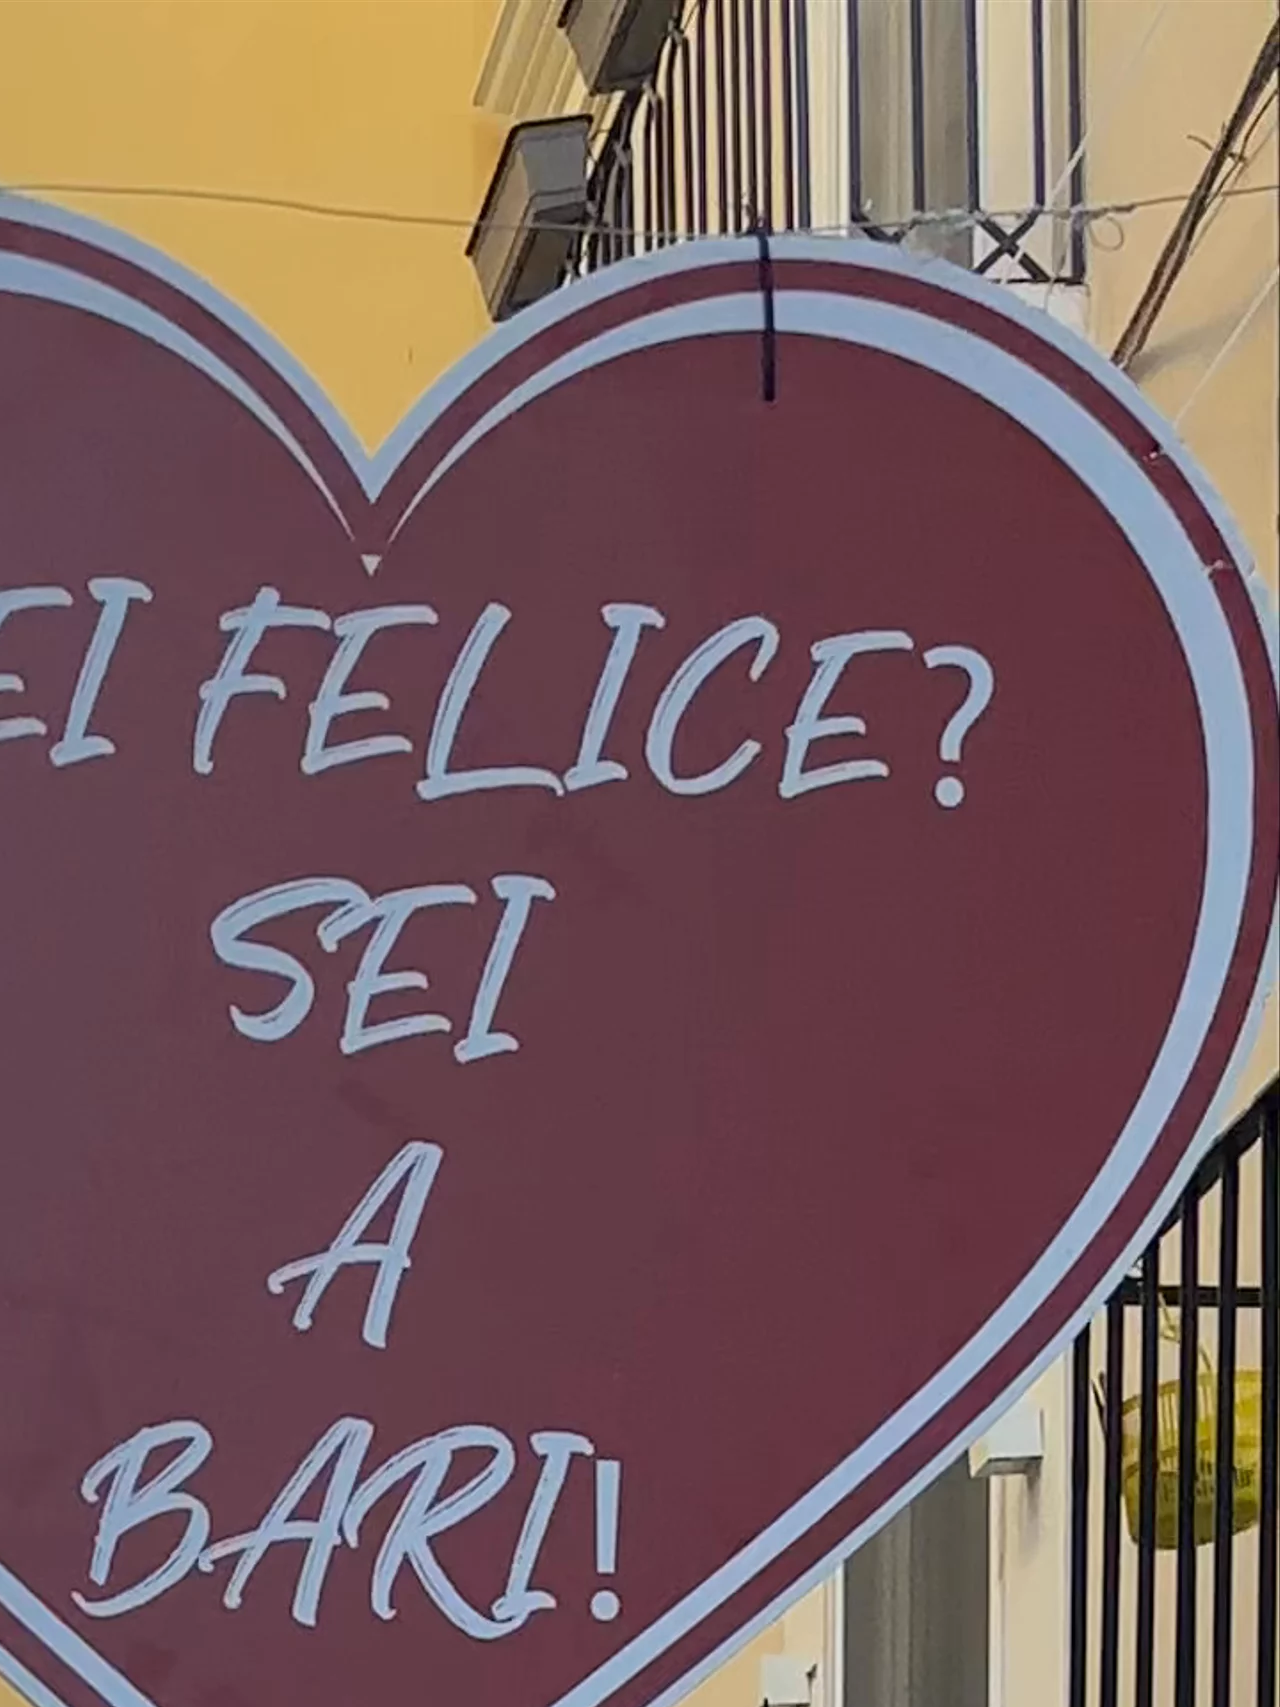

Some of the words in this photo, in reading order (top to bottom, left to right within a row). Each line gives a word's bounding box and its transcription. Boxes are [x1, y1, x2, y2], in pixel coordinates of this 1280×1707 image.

[193, 586, 994, 808] FELICE?
[210, 874, 557, 1064] SEI
[267, 1141, 444, 1349] A
[72, 1416, 622, 1638] BARI!
